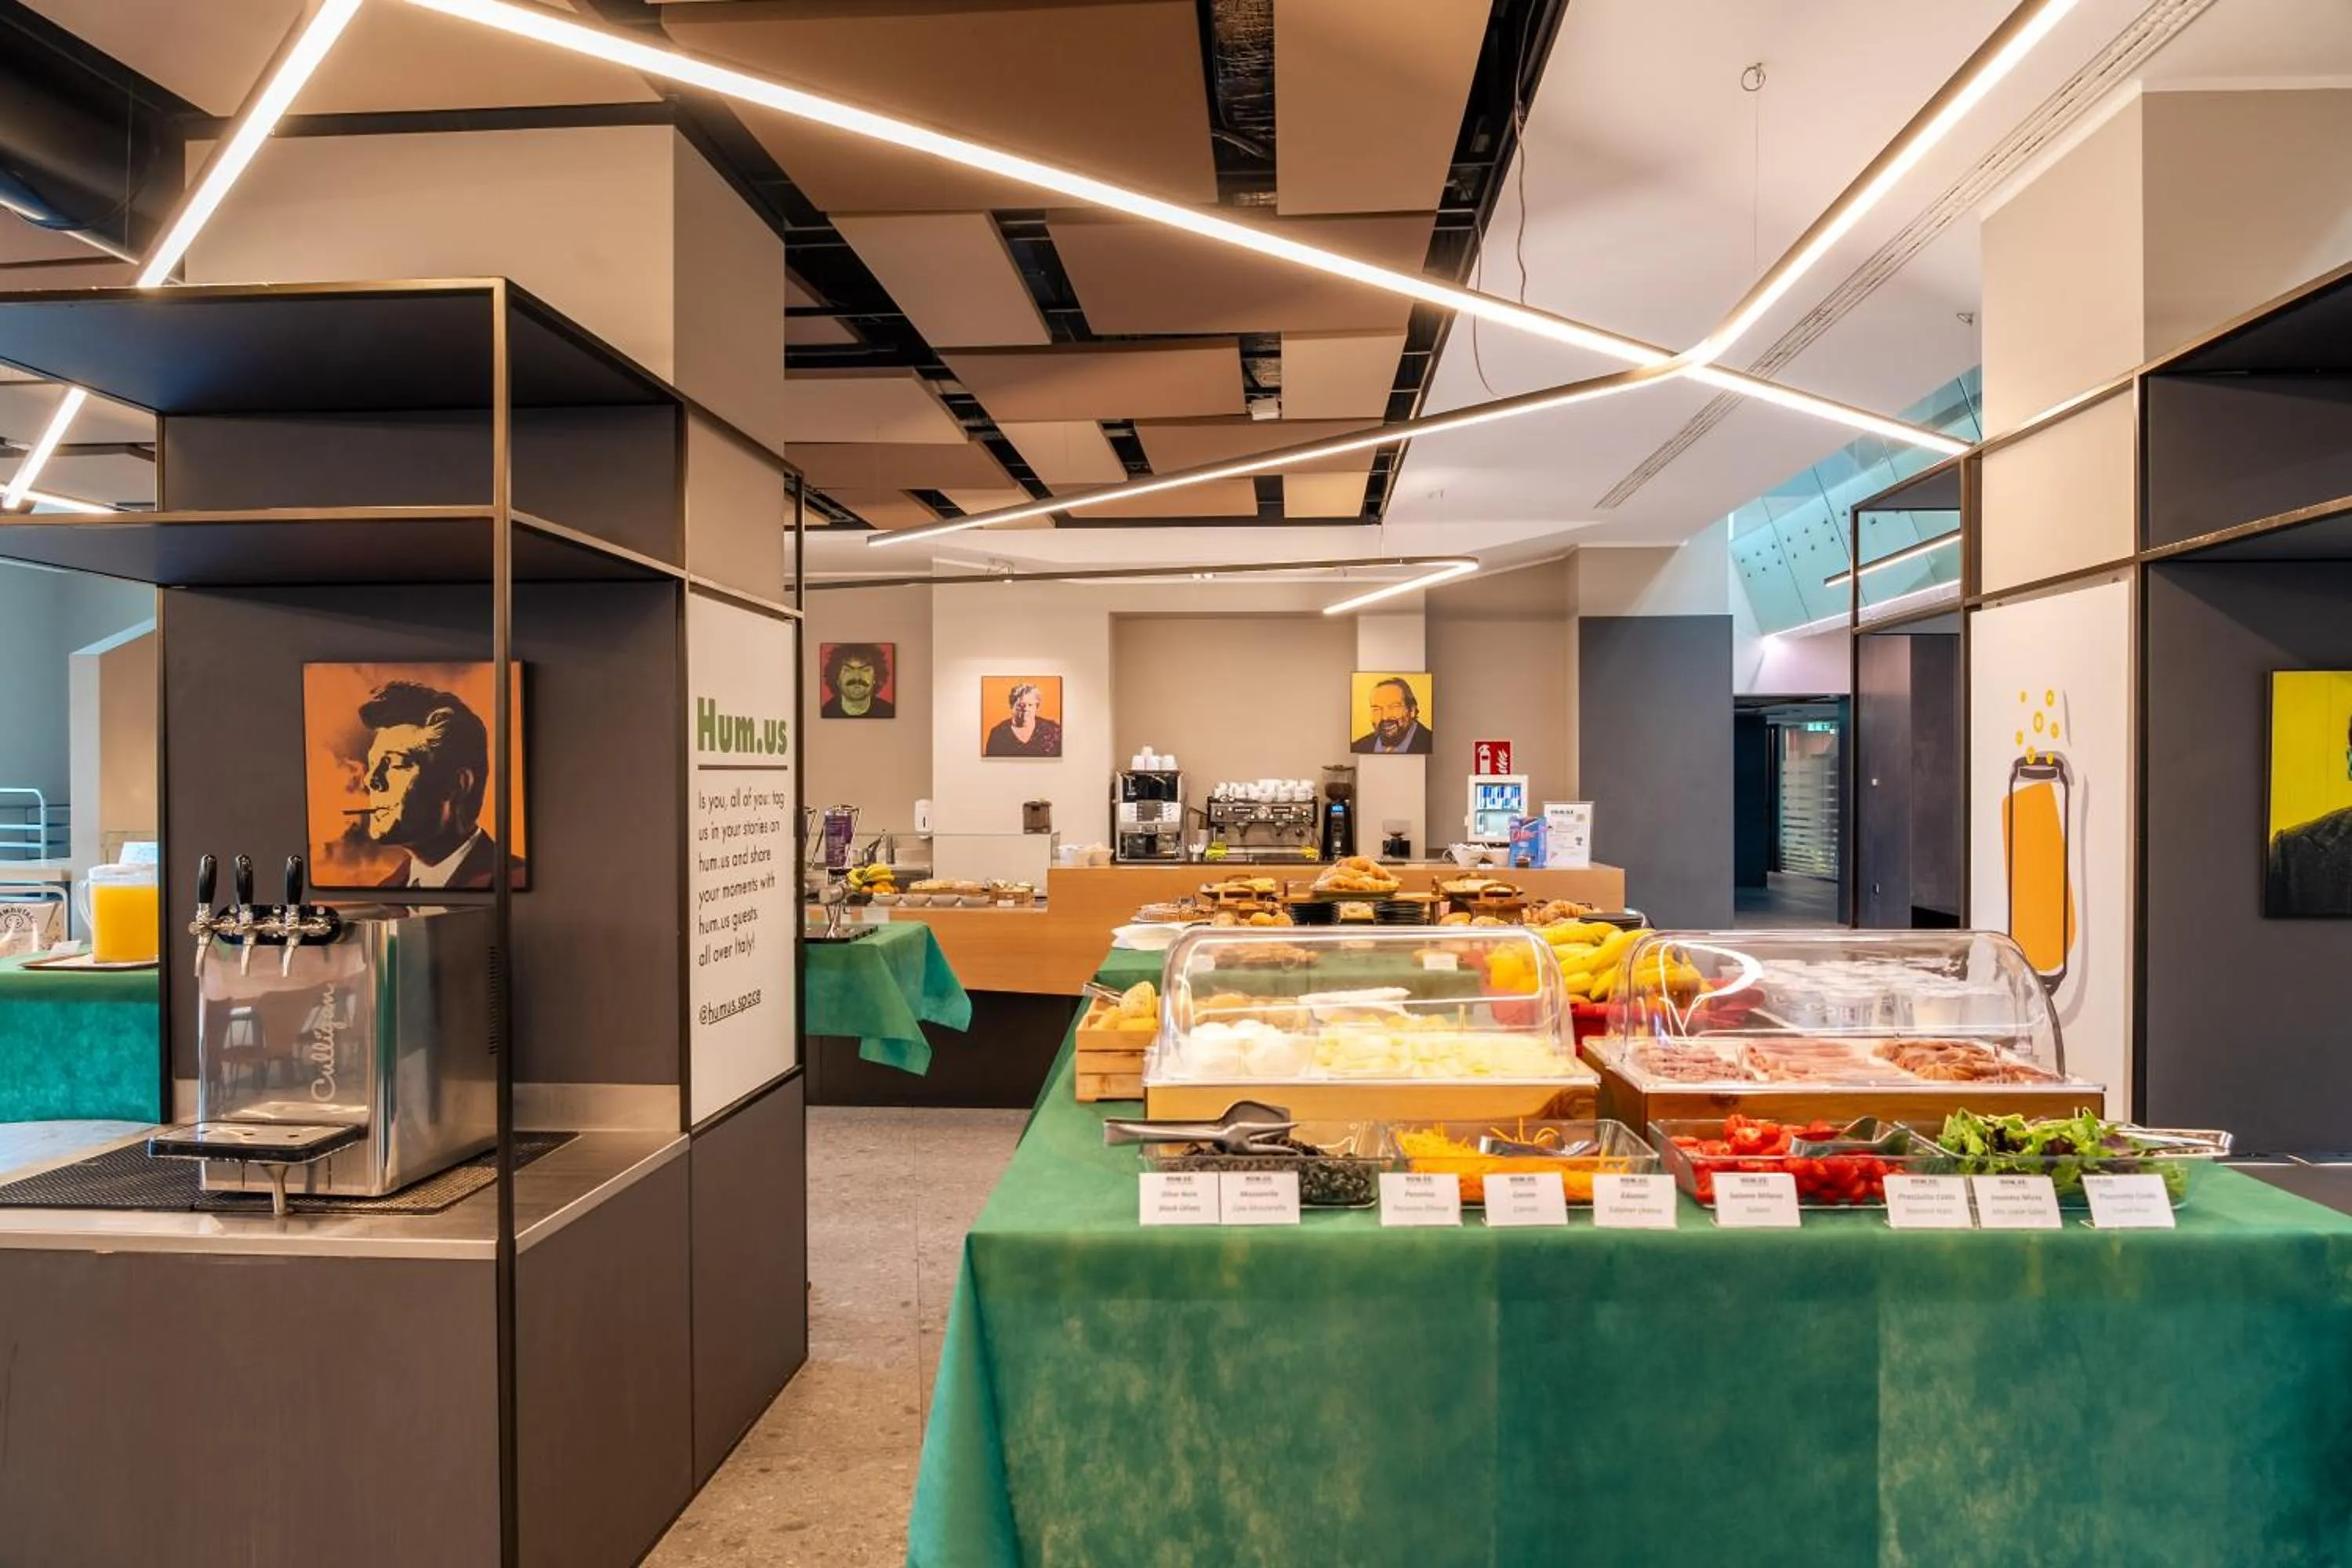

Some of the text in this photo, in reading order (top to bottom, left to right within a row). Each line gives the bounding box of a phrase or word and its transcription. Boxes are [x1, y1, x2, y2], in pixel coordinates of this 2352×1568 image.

[697, 696, 788, 755] Hum.us
[699, 789, 706, 810] Is
[708, 795, 728, 815] you,
[730, 787, 741, 808] all
[742, 786, 752, 807] of
[772, 789, 785, 811] tag
[699, 817, 780, 844] us in your stories on
[699, 844, 771, 873] hum.us and share
[699, 871, 775, 910] your moments with
[699, 906, 759, 936] hum.us guests
[699, 944, 711, 967] all
[713, 943, 734, 964] over
[310, 981, 347, 1103] Culligan
